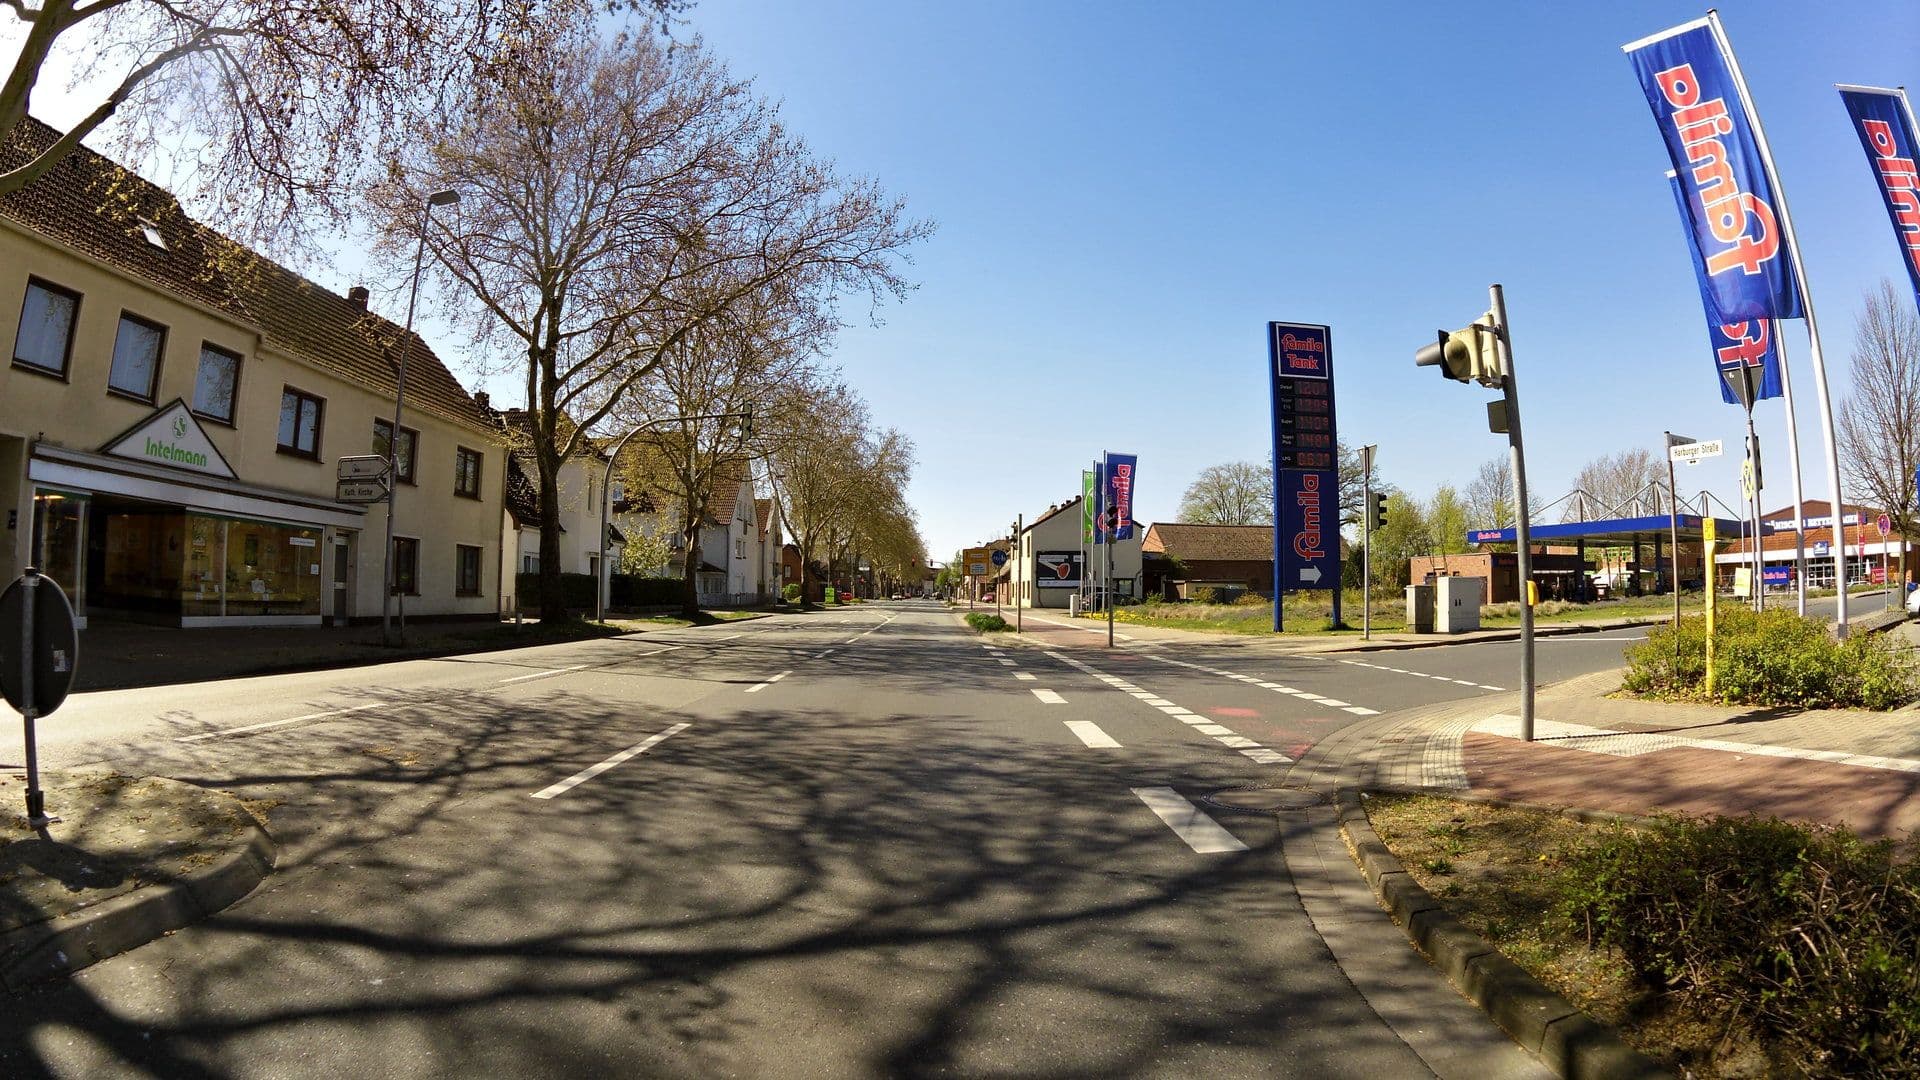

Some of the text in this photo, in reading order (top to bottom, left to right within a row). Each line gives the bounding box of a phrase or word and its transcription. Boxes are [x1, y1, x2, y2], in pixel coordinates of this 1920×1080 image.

[1282, 333, 1323, 352] famila
[1287, 354, 1319, 369] Tank
[145, 437, 207, 467] Intelmann
[1674, 446, 1699, 457] Harburger
[1293, 473, 1325, 562] famila
